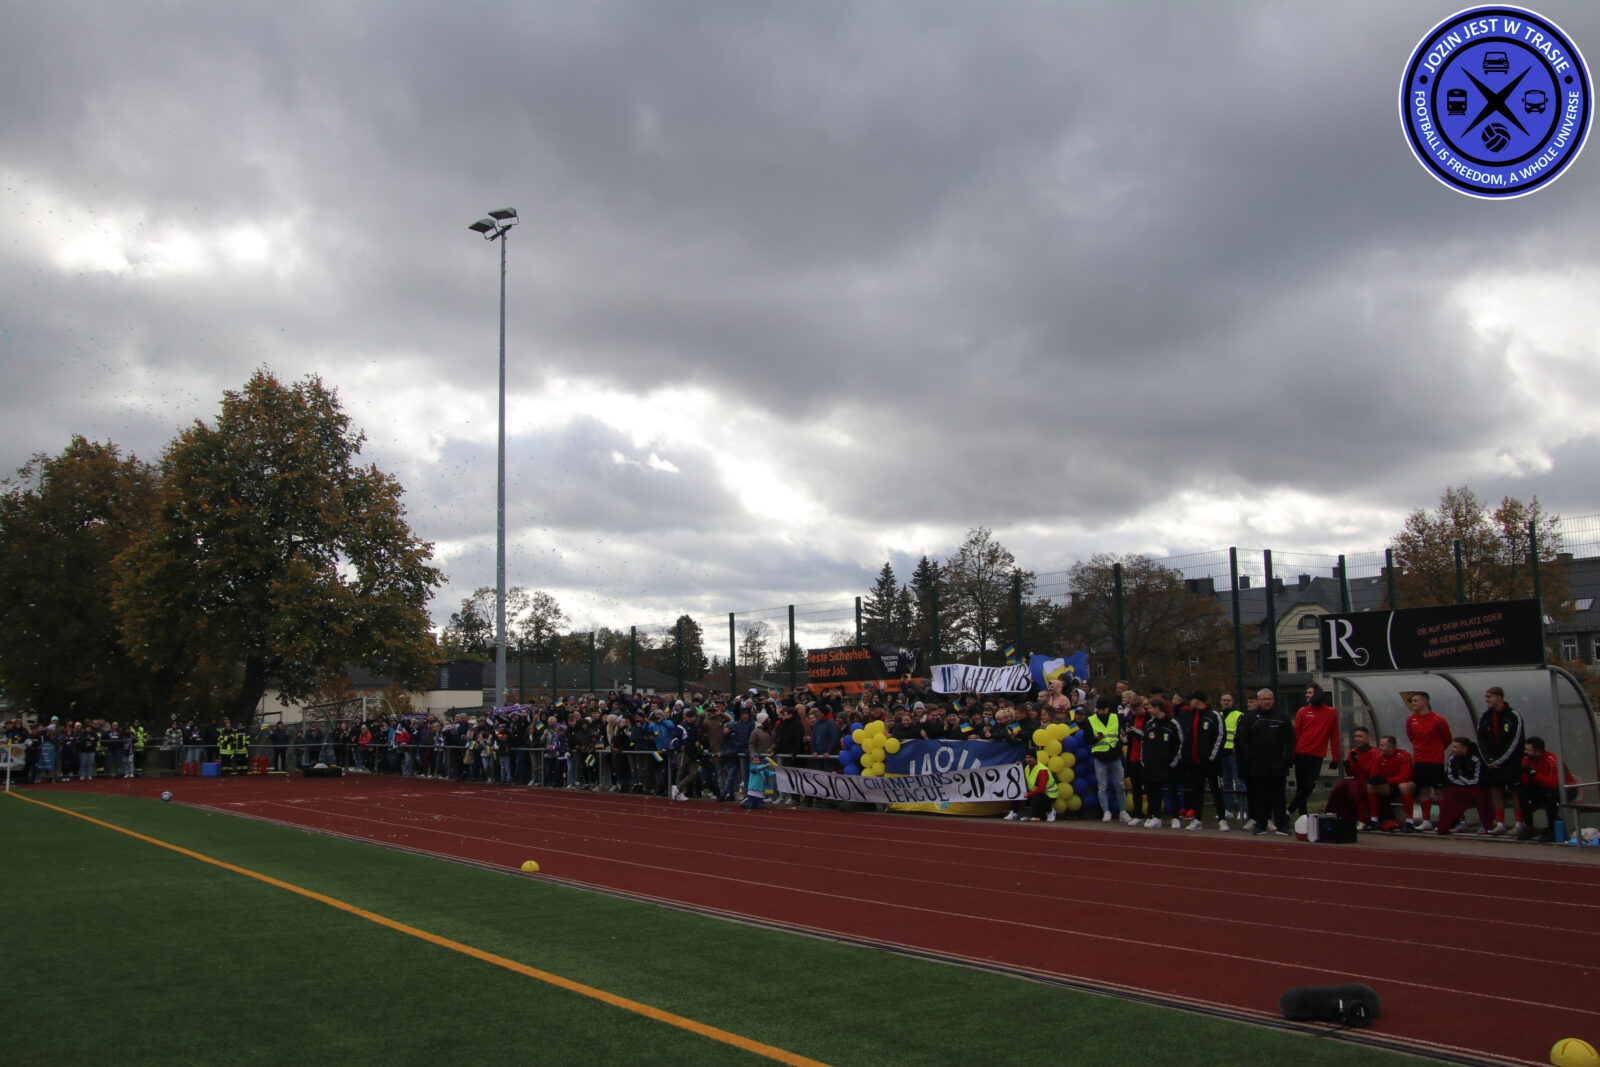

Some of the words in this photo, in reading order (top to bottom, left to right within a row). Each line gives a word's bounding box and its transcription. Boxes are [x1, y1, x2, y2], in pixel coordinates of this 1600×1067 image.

[1428, 624, 1441, 633] AUF
[1442, 621, 1459, 631] DEM
[1460, 616, 1482, 626] PLATZ
[1483, 612, 1504, 622] ODER
[829, 647, 872, 662] Sicherheit.
[1457, 643, 1473, 652] UND
[832, 665, 848, 676] Job.
[783, 768, 867, 801] MISSION
[863, 772, 953, 791] CHAMPIONS
[953, 766, 1021, 800] 2028
[884, 786, 950, 803] LEAGUE
